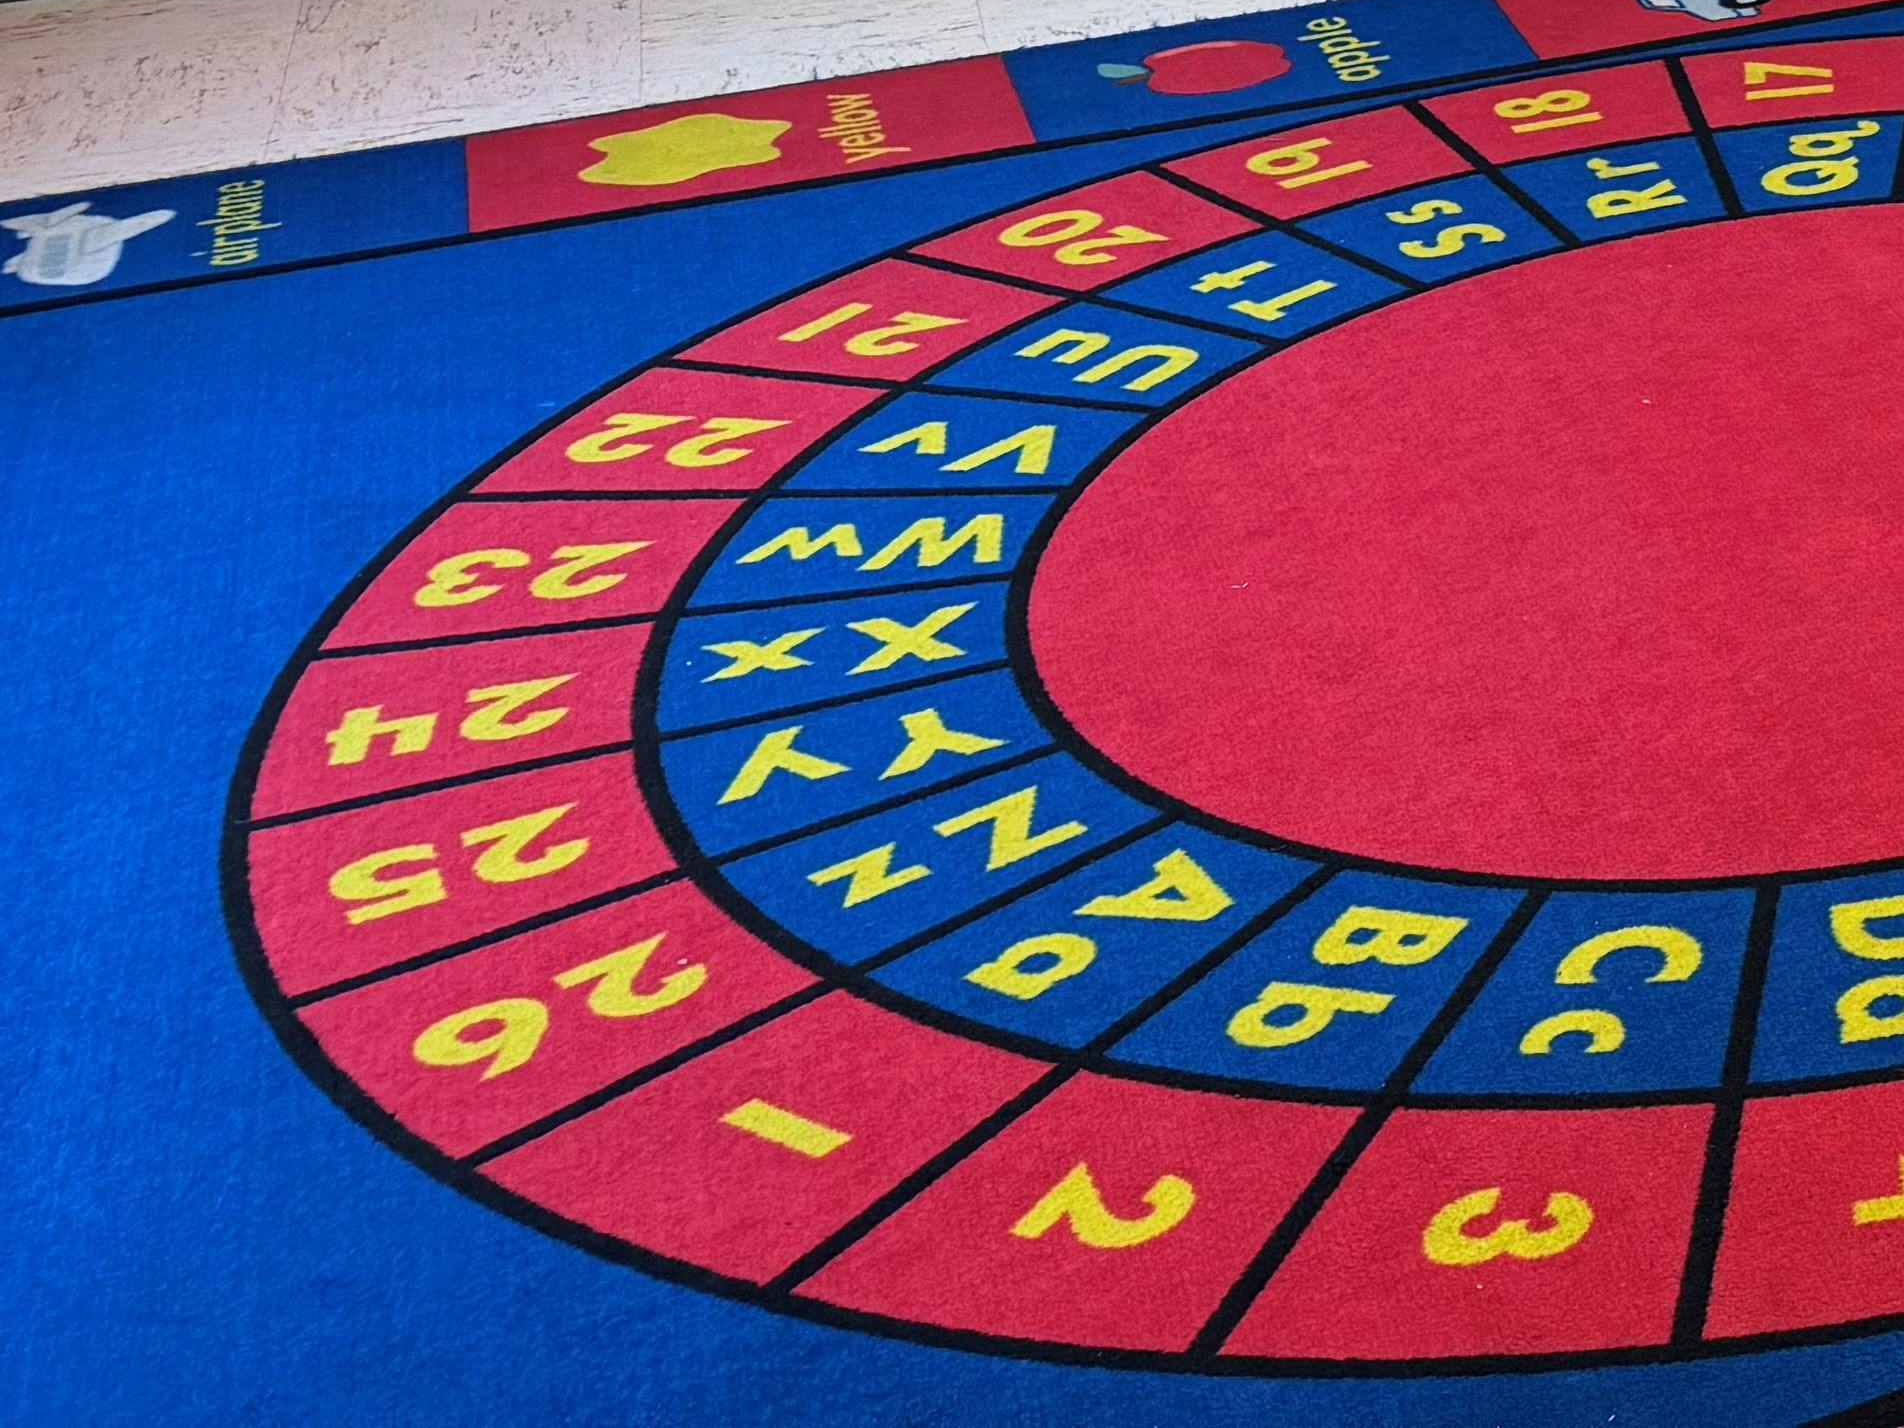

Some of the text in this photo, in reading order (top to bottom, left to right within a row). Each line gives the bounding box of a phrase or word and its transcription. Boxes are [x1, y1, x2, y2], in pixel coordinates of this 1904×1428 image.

[1296, 16, 1393, 82] apple
[817, 91, 909, 164] yellow
[187, 175, 284, 267] airplane
[1012, 1163, 1196, 1248] 2
[1422, 1188, 1595, 1266] 3
